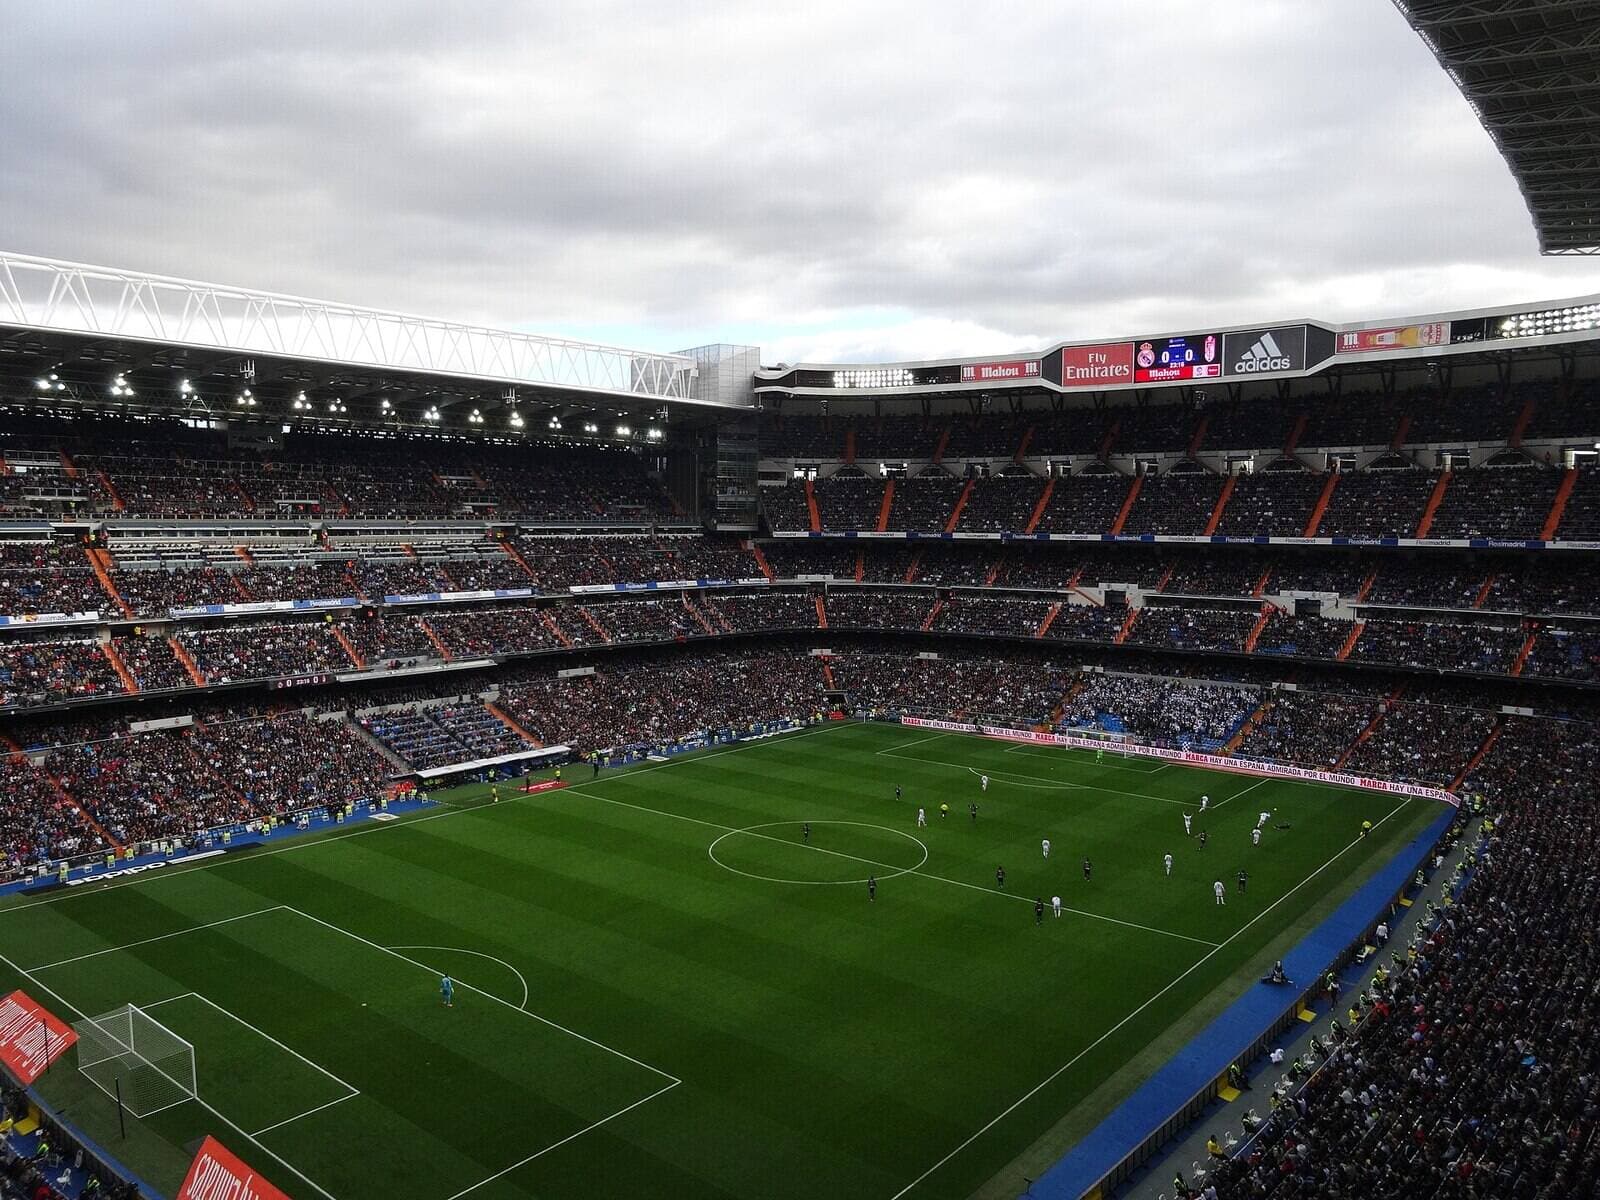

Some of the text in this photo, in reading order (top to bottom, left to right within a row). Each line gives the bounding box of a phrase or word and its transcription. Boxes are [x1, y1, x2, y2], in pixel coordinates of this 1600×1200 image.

[1088, 352, 1106, 364] Fly
[1162, 351, 1170, 363] 0
[1185, 349, 1193, 362] 0
[1066, 364, 1130, 379] Emirates
[1235, 356, 1291, 373] adidas
[981, 366, 1020, 378] Mahou
[1149, 368, 1180, 378] Mahou
[1186, 753, 1208, 762] MARCA
[1210, 756, 1222, 764] HAY
[1267, 765, 1301, 776] ADMIRADA
[1304, 770, 1317, 779] POR
[1328, 774, 1355, 784] MUNDO
[1360, 779, 1388, 790] MARCA
[1390, 784, 1405, 792] HAY
[1407, 786, 1423, 795] UNA
